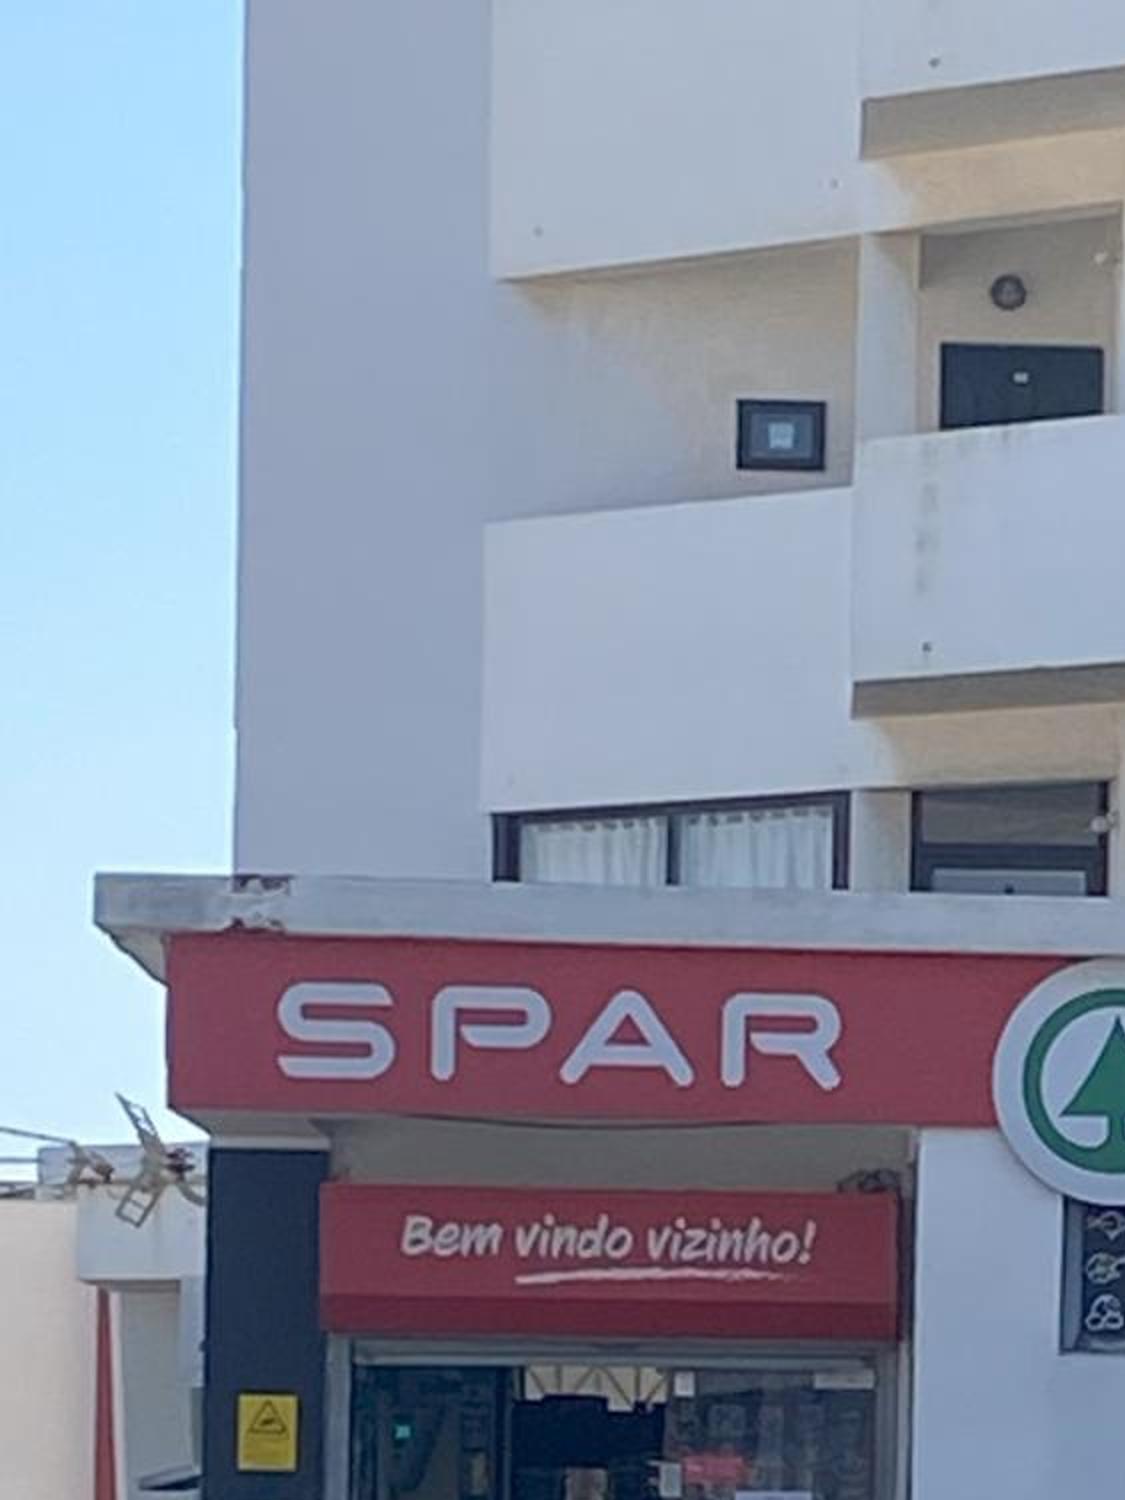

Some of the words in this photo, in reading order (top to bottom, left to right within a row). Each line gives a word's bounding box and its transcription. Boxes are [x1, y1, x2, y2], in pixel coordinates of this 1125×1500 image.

[277, 981, 842, 1090] SPAR
[402, 1214, 503, 1257] Bem
[515, 1213, 633, 1258] vindo
[648, 1216, 817, 1264] vizinho!
